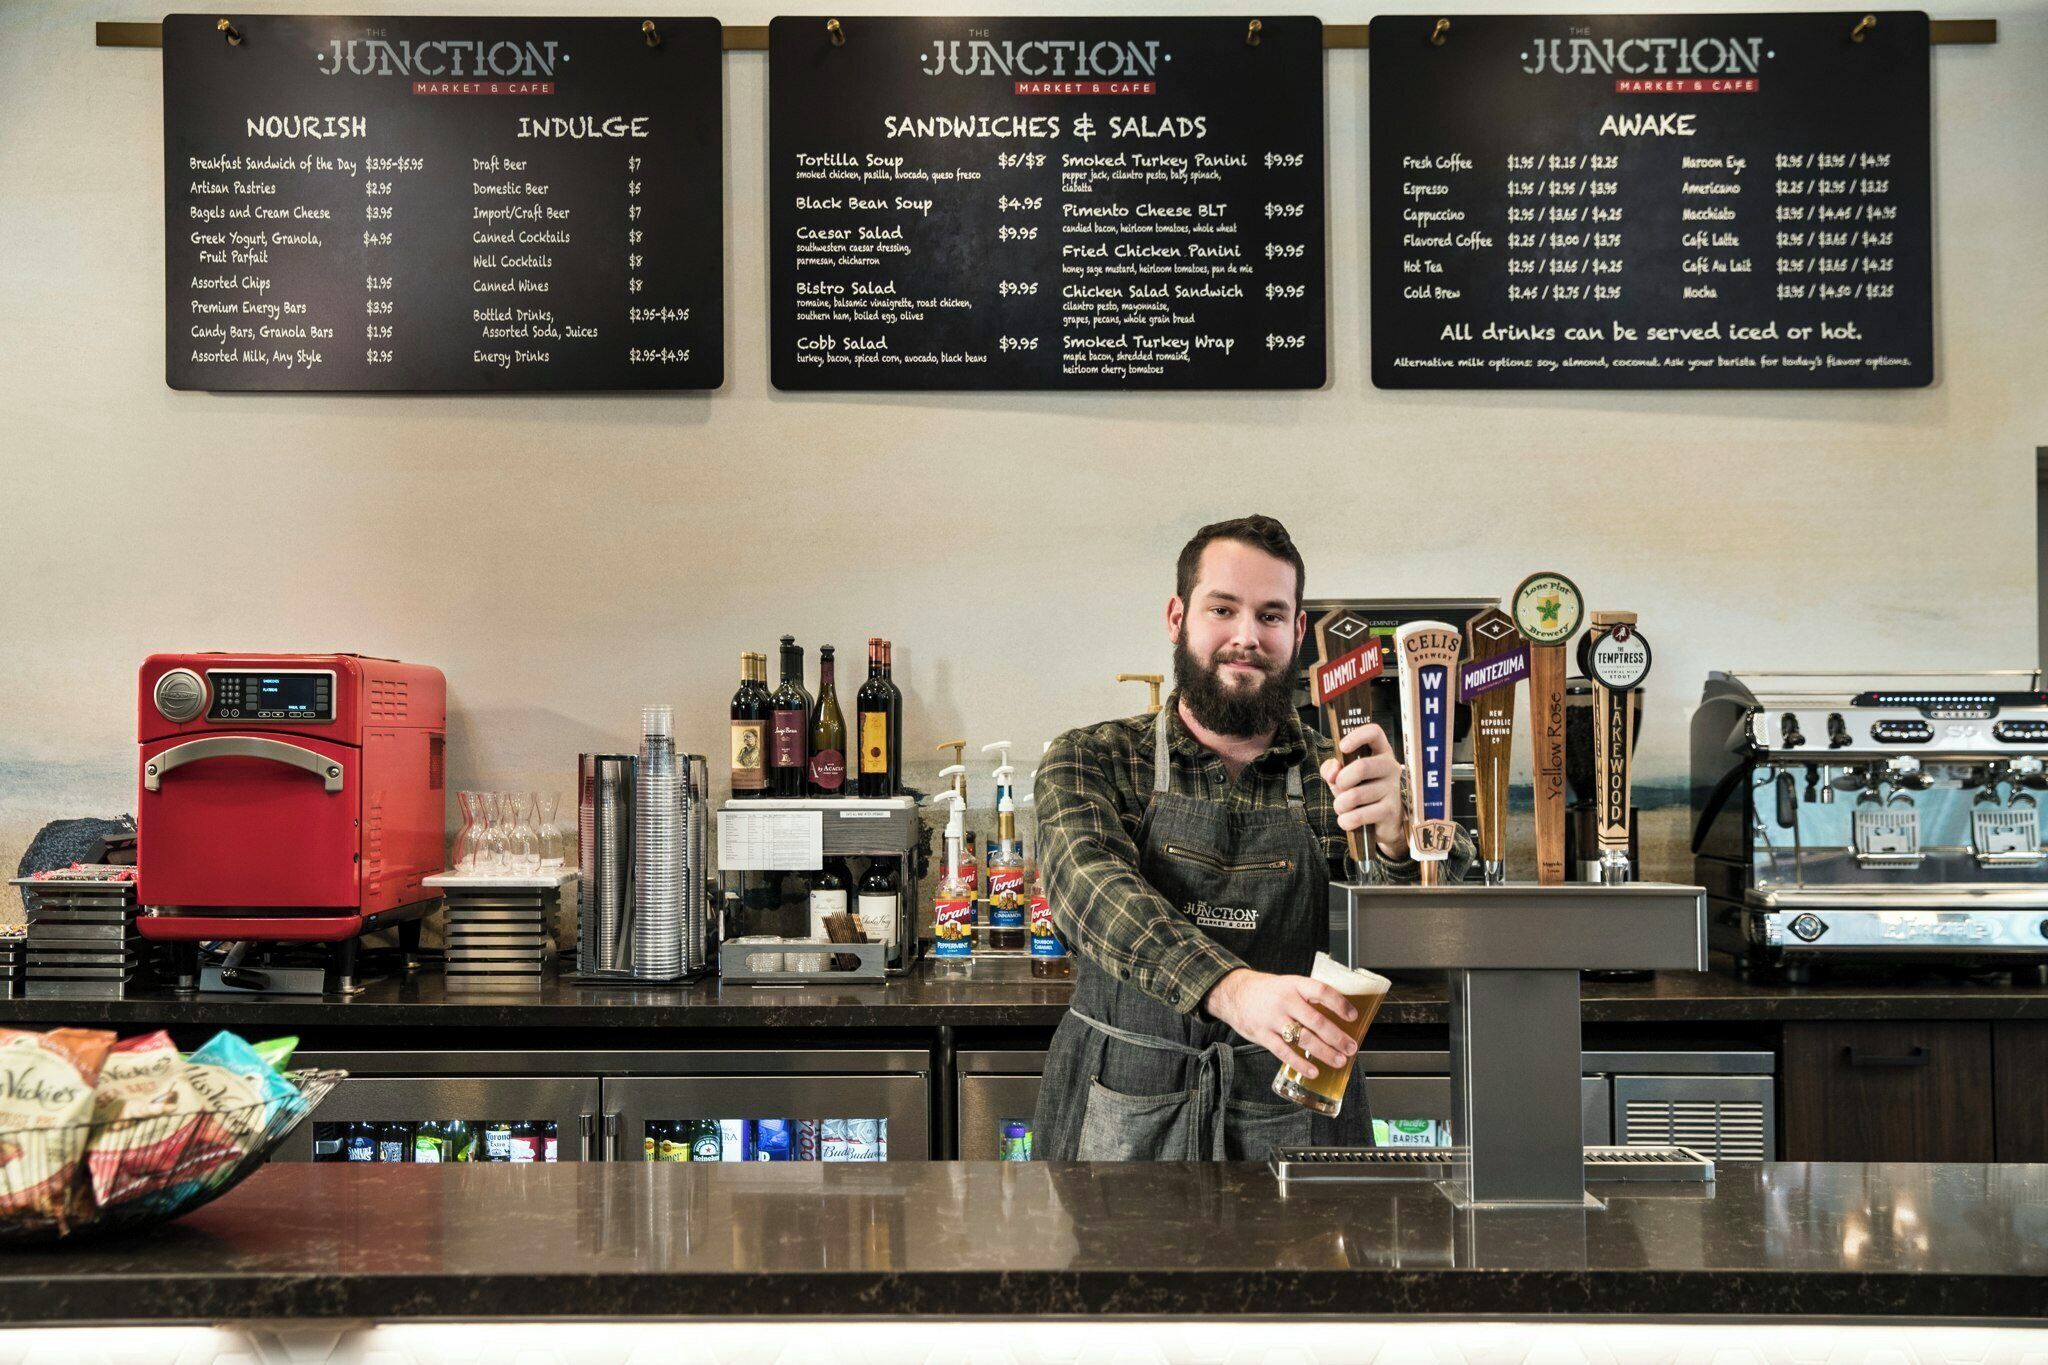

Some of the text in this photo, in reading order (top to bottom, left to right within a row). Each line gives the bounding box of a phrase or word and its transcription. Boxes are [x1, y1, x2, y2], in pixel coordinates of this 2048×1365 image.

[320, 40, 558, 75] JUNCTION
[922, 40, 1160, 76] JUNCTION
[1523, 37, 1764, 75] JUNCTION
[417, 83, 549, 93] MARKET & CAFE
[246, 114, 367, 140] NOURISH
[516, 115, 650, 139] INDULGE
[884, 111, 1207, 143] SANDWICHES & SALADS
[1599, 111, 1697, 138] AWAKE
[189, 153, 242, 174] Breakfast
[245, 155, 296, 171] Sandwich
[299, 154, 313, 174] of
[316, 156, 334, 171] the
[336, 157, 357, 178] Day
[795, 151, 1047, 174] Tortilla Soup $5/$8
[1061, 151, 1305, 171] Smoked Turkey Panini $9.95
[1402, 155, 1433, 170] Fresh
[1435, 152, 1474, 173] Coffee
[1506, 153, 1535, 172] $1.95
[1548, 153, 1577, 172] $2.15
[1590, 153, 1619, 172] $2.25
[472, 203, 642, 227] Import/Craft Beer $7
[795, 194, 1043, 218] Black Bean Soup $4.95
[1062, 201, 1305, 220] Pimento Cheese BLT $9.95
[1681, 205, 1737, 222] Macchiato
[1062, 221, 1093, 234] candied
[1119, 222, 1154, 234] heirloom
[1192, 222, 1215, 234] whole
[1215, 222, 1238, 234] wheat
[1402, 207, 1466, 229] Cappuccino
[190, 230, 393, 249] Greek Yogurt, Granola, $4.95
[796, 224, 1039, 243] Caesar Salad $9.95
[1403, 230, 1494, 251] Flavored Coffee
[1681, 229, 1741, 250] Café Latte
[199, 249, 268, 266] Fruit Parfait
[796, 241, 847, 257] southwestern
[848, 244, 875, 257] caesar
[1062, 241, 1305, 261] Fried Chicken Panini $9.95
[796, 279, 1039, 298] Bistro Salad $9.95
[833, 295, 868, 312] balsamic
[916, 296, 938, 308] roast
[473, 306, 513, 322] Bottled
[517, 309, 554, 323] Drinks,
[1439, 319, 1863, 342] All drinks can be served iced or hot.
[1393, 356, 1455, 368] Alternative
[1457, 357, 1486, 368] milk
[1663, 357, 1685, 367] Ask
[1687, 358, 1715, 372] your
[1717, 355, 1757, 367] barista
[1759, 354, 1780, 369] for
[1825, 353, 1863, 368] flavor
[1524, 582, 1571, 598] Lone Pint
[1526, 623, 1569, 637] Brewery
[1407, 634, 1459, 653] CELIS
[1414, 653, 1453, 662] BREWERY
[1598, 653, 1643, 663] TEMPTRESS
[1323, 646, 1379, 694] DAMMIT JIM!
[1465, 654, 1524, 690] MONTEZUMA
[1341, 716, 1370, 725] REPUBLIC
[1422, 672, 1442, 788] WHITE
[1542, 691, 1562, 800] Yellow Rose
[1610, 695, 1624, 820] LAKEWOOD
[935, 901, 970, 926] Torani
[1030, 903, 1052, 921] Tora
[1184, 902, 1256, 921] JUNCTION
[486, 1133, 510, 1141] Corona
[1393, 1135, 1431, 1144] BARISTA
